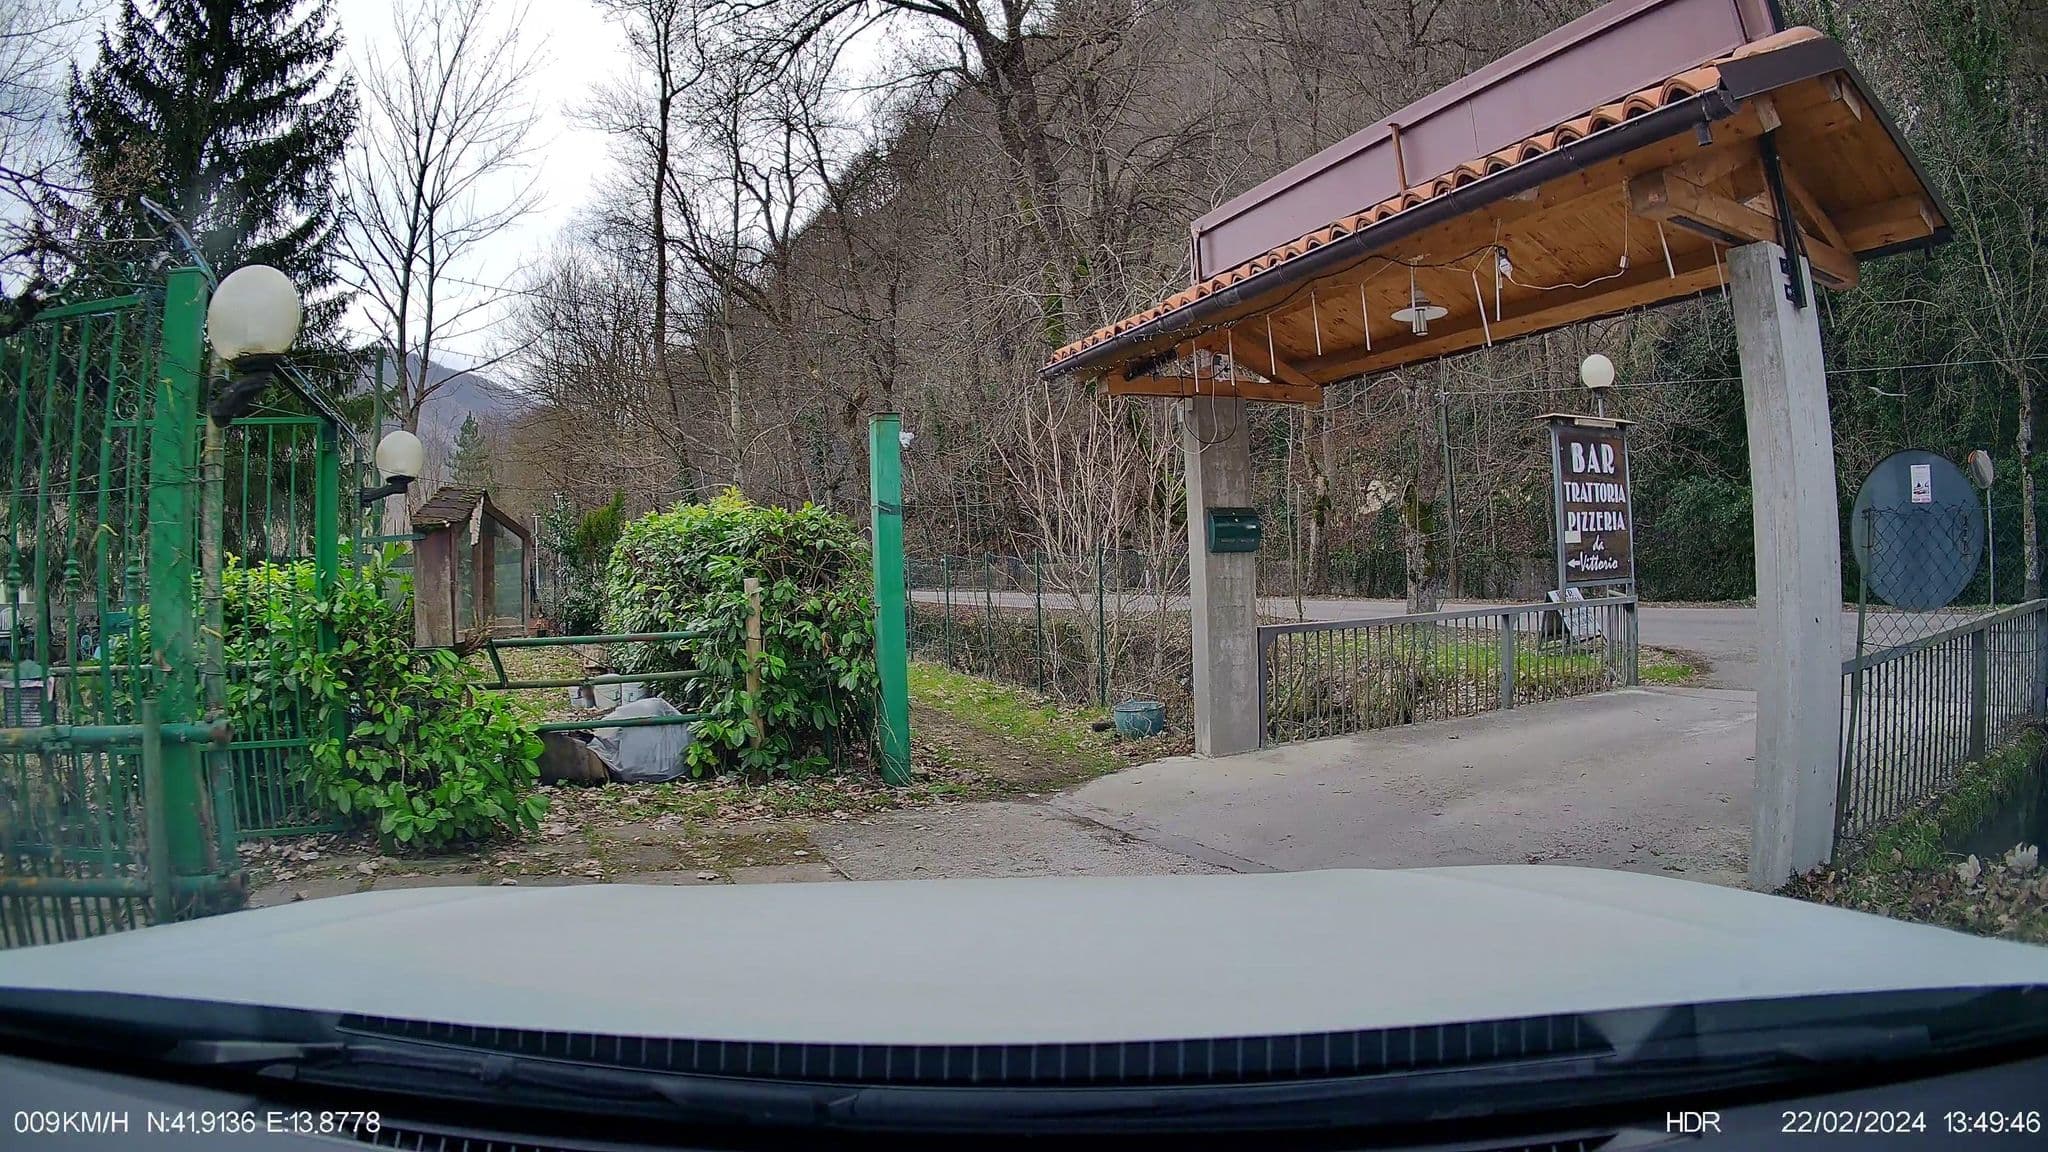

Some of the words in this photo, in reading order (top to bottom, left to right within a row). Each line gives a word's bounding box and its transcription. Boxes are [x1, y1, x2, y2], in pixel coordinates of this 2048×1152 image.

[1571, 442, 1615, 474] BAR
[1564, 481, 1626, 503] TRATTORIA
[1567, 511, 1626, 532] PIZZERIA
[1592, 534, 1605, 551] da
[1580, 551, 1619, 572] Vittorio
